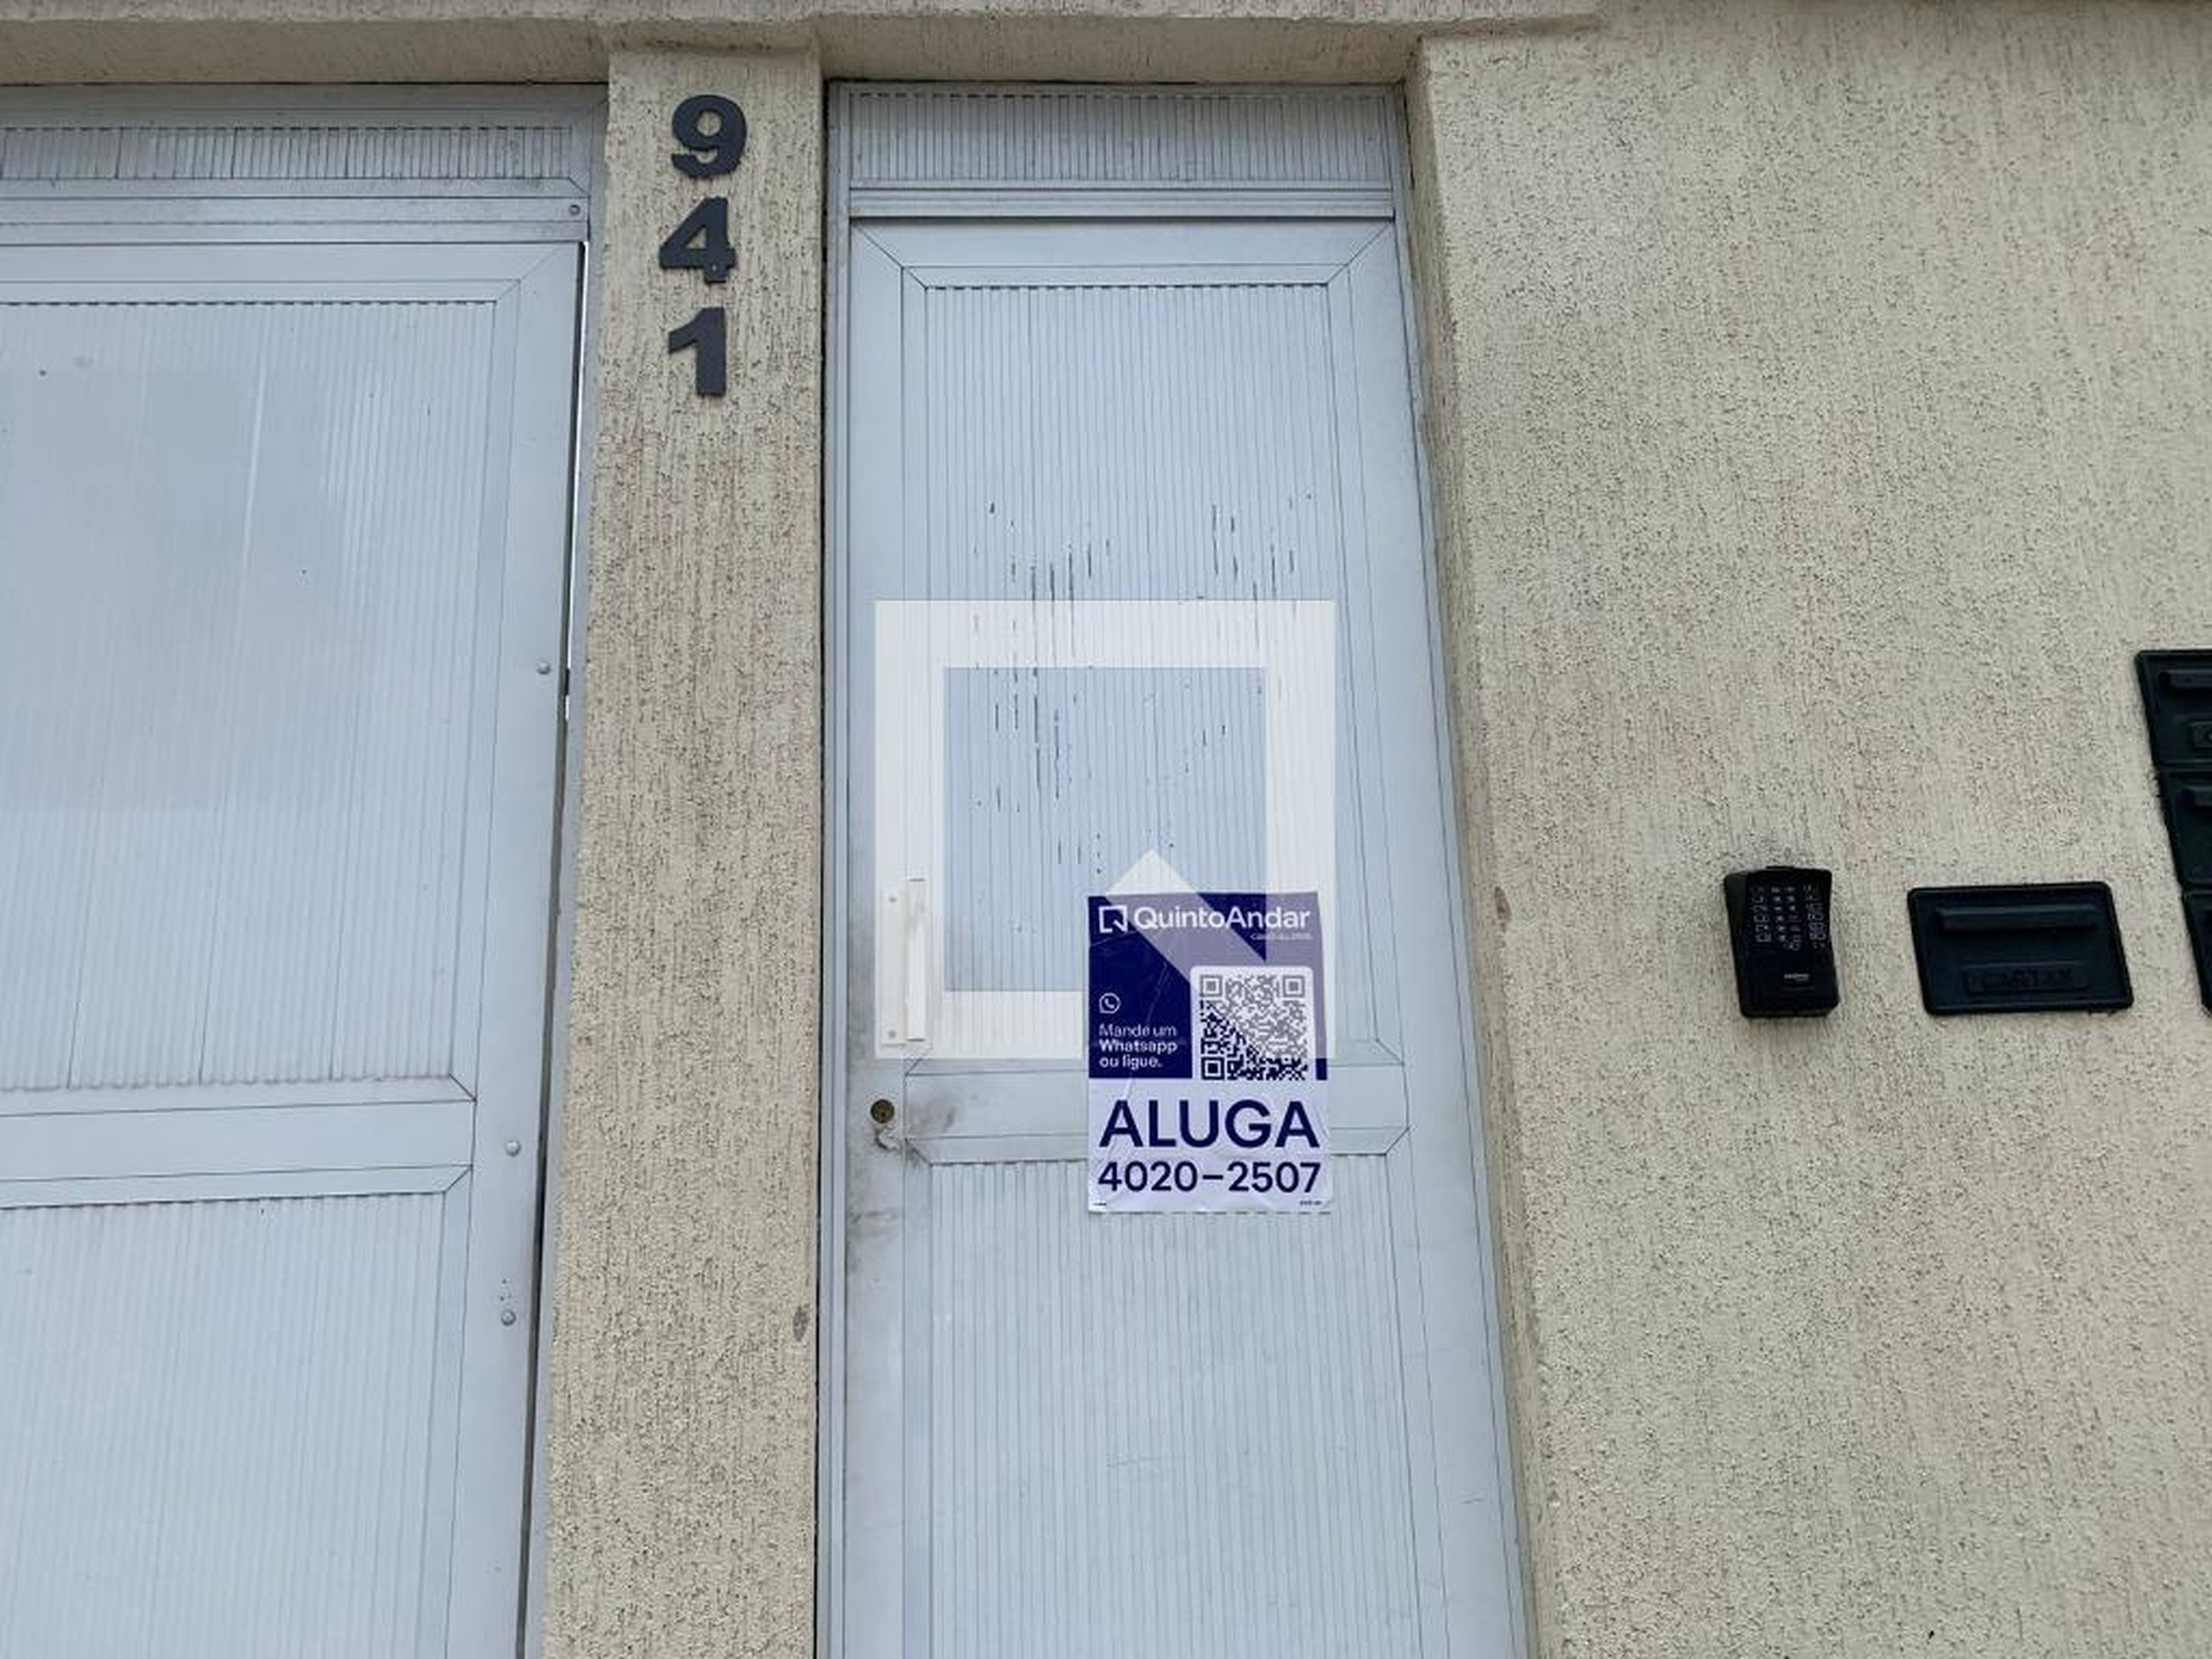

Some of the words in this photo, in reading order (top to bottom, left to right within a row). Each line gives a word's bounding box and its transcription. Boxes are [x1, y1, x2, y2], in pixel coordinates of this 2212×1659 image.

[658, 94, 748, 397] 941
[1134, 906, 1311, 930] QuintoAndar
[1099, 1023, 1150, 1037] Mande
[1153, 1025, 1177, 1037] um
[1099, 1039, 1178, 1055] Whatsapp
[1099, 1056, 1119, 1067] ou
[1122, 1054, 1163, 1070] ligue.
[1099, 1099, 1320, 1148] ALUGA
[1097, 1160, 1321, 1193] 4020-2507
